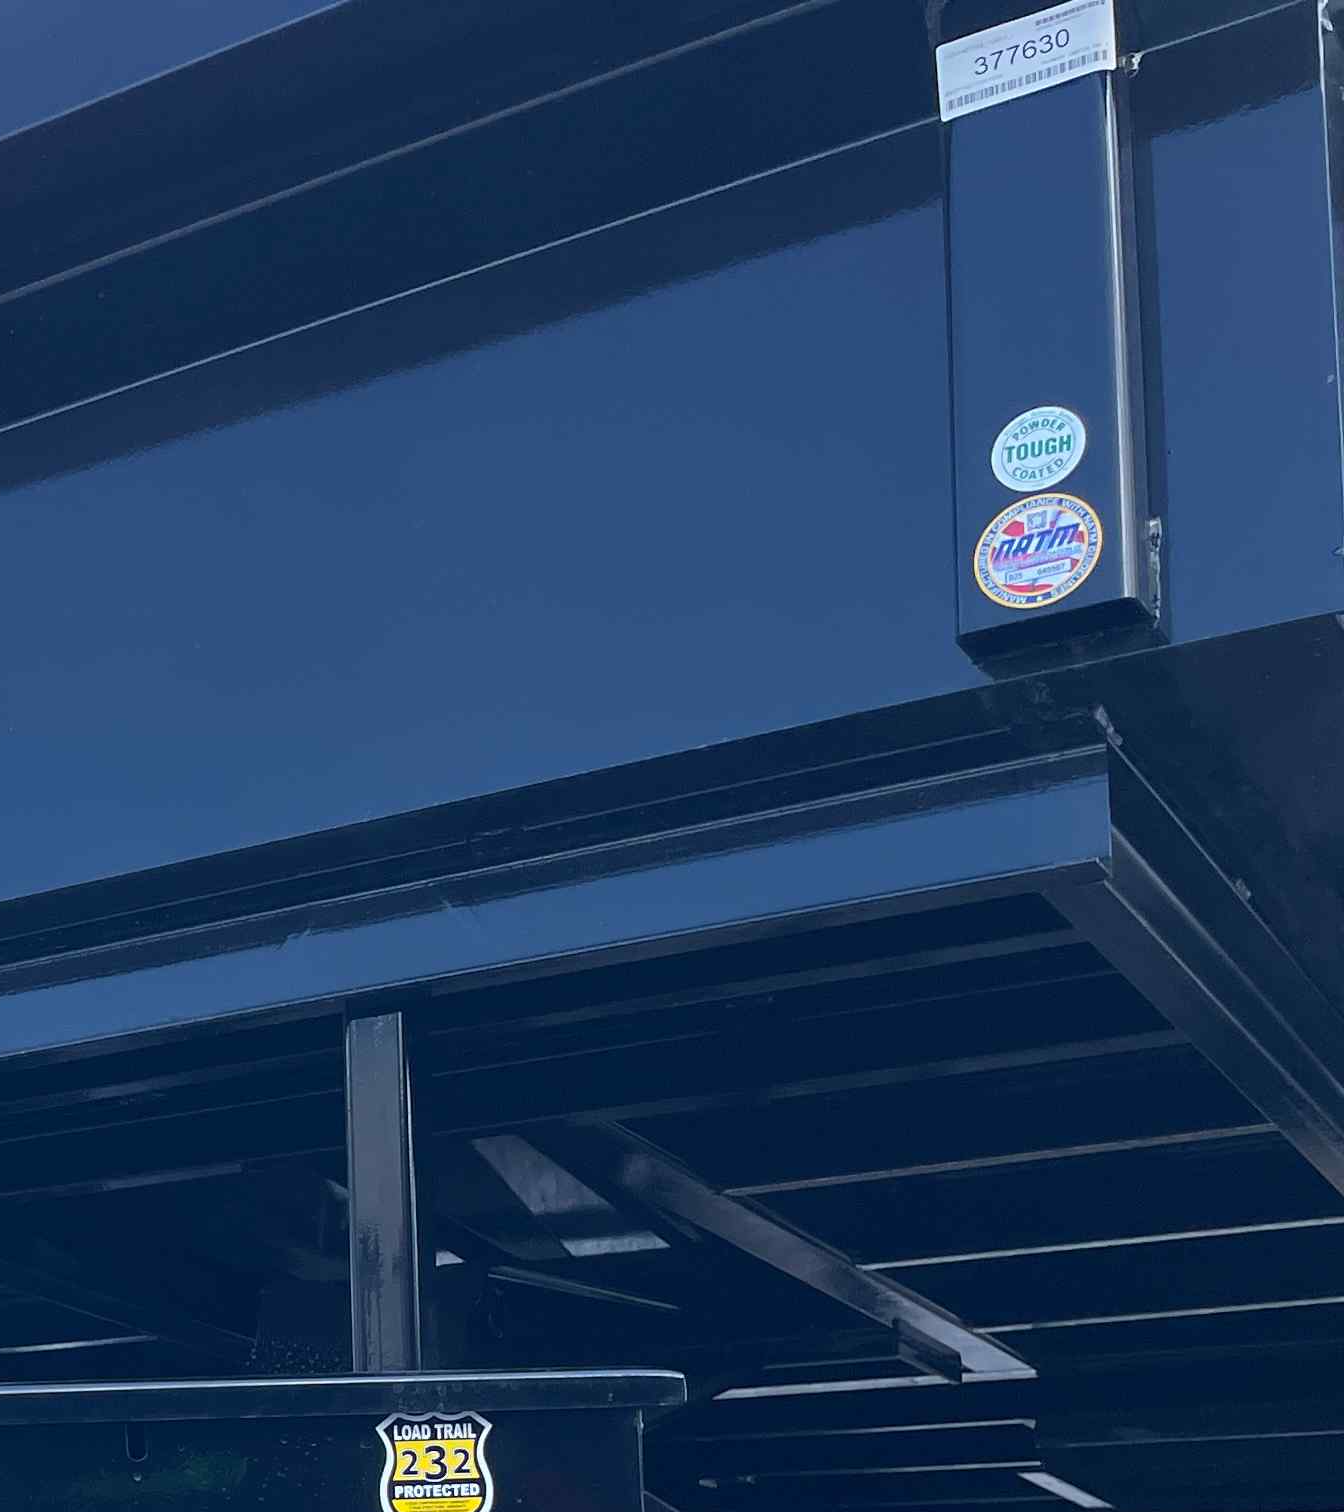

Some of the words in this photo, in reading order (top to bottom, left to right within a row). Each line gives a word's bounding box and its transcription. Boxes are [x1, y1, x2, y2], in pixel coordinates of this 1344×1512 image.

[974, 29, 1070, 75] 377630
[1013, 417, 1067, 441] POWDER
[1005, 434, 1073, 464] TOUGH
[1012, 457, 1064, 480] COATED
[393, 1425, 432, 1441] LOAD
[434, 1423, 477, 1440] TRAIL
[401, 1444, 472, 1481] 232
[394, 1483, 481, 1499] PROTECTED
